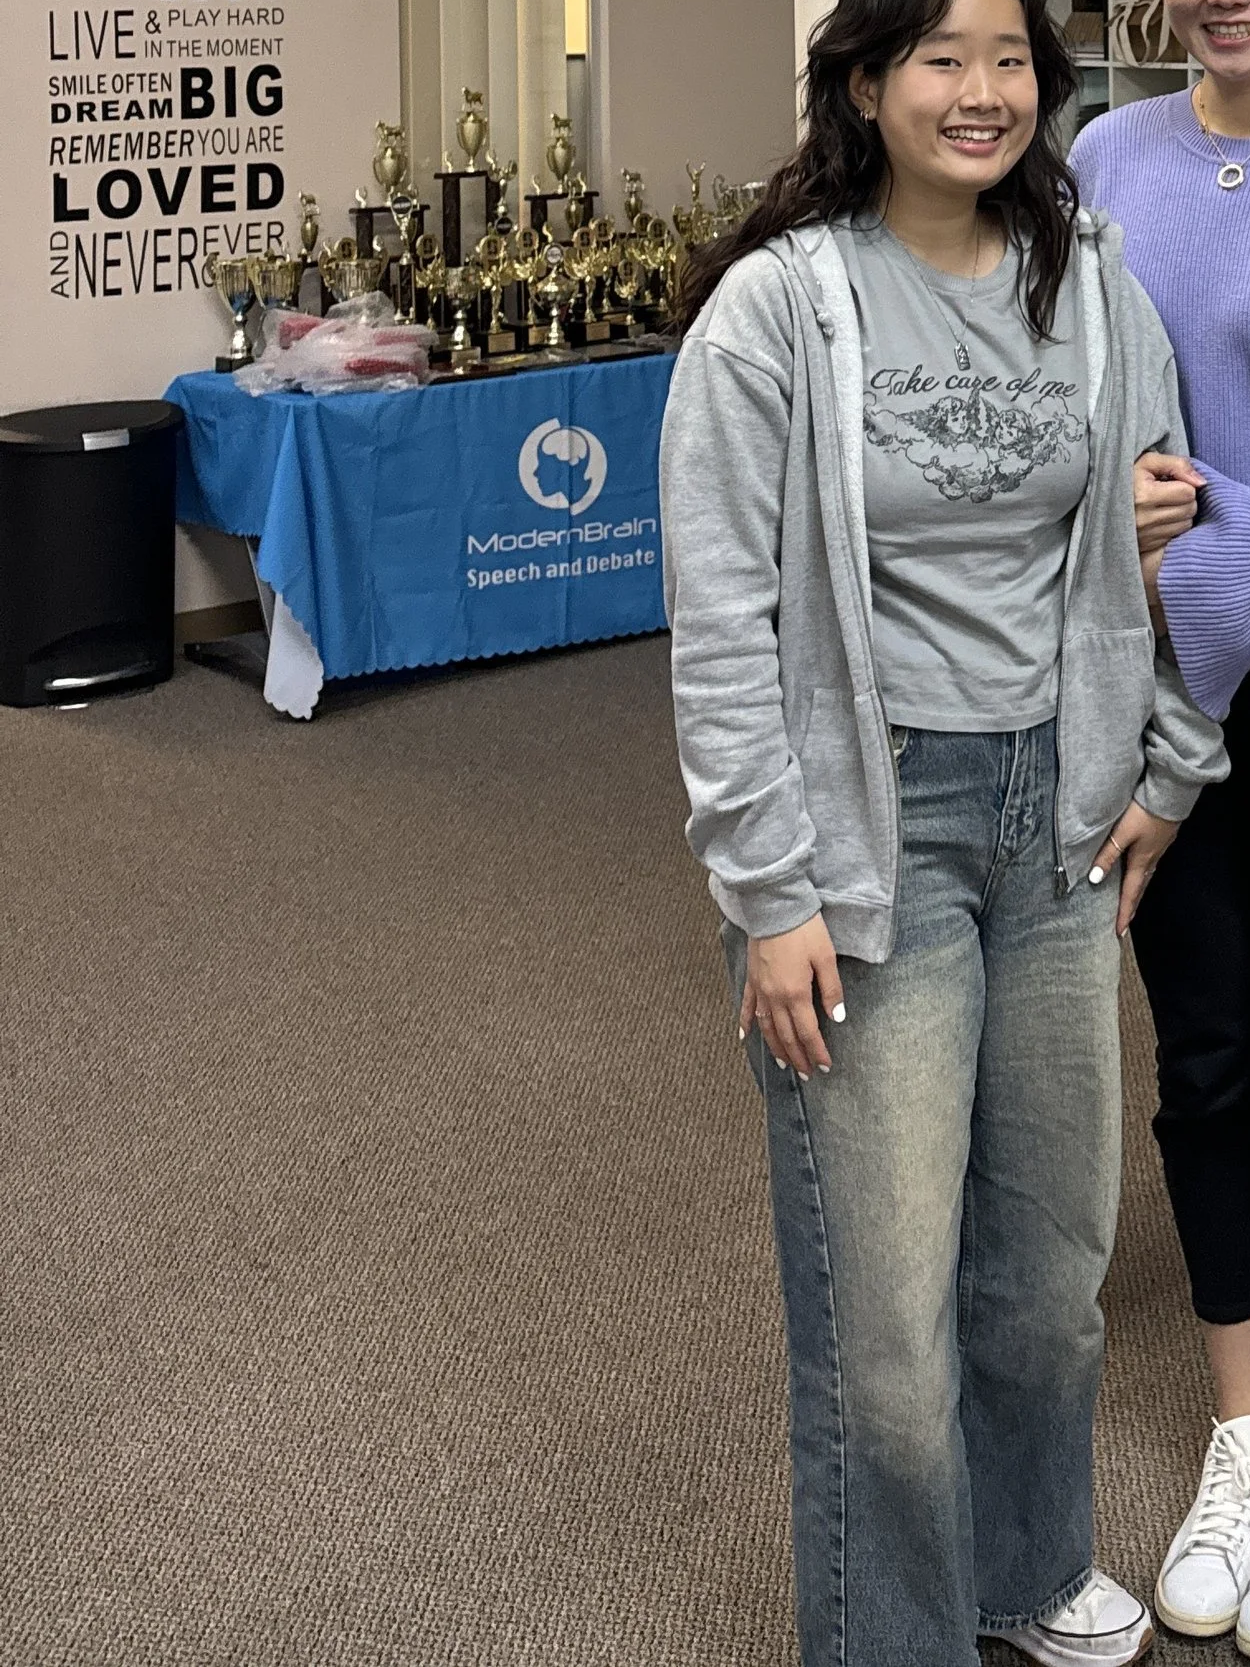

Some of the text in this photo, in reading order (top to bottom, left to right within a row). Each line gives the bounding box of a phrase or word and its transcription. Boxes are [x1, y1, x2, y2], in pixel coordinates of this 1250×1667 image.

[48, 7, 285, 61] LIVE & PLAY HARD
[144, 37, 284, 58] IN THE MOMENT
[48, 72, 172, 97] SMILE OFTEN
[50, 63, 284, 124] DREAM BIG
[49, 125, 284, 166] REMEMBER YOU ARE
[52, 162, 285, 224] LOVED
[49, 230, 70, 299] AND
[75, 226, 200, 300] NEVER
[202, 220, 285, 256] EVER
[870, 363, 1080, 402] Take care of me
[467, 518, 657, 555] ModernBrain
[467, 548, 656, 590] Speech and Debate
